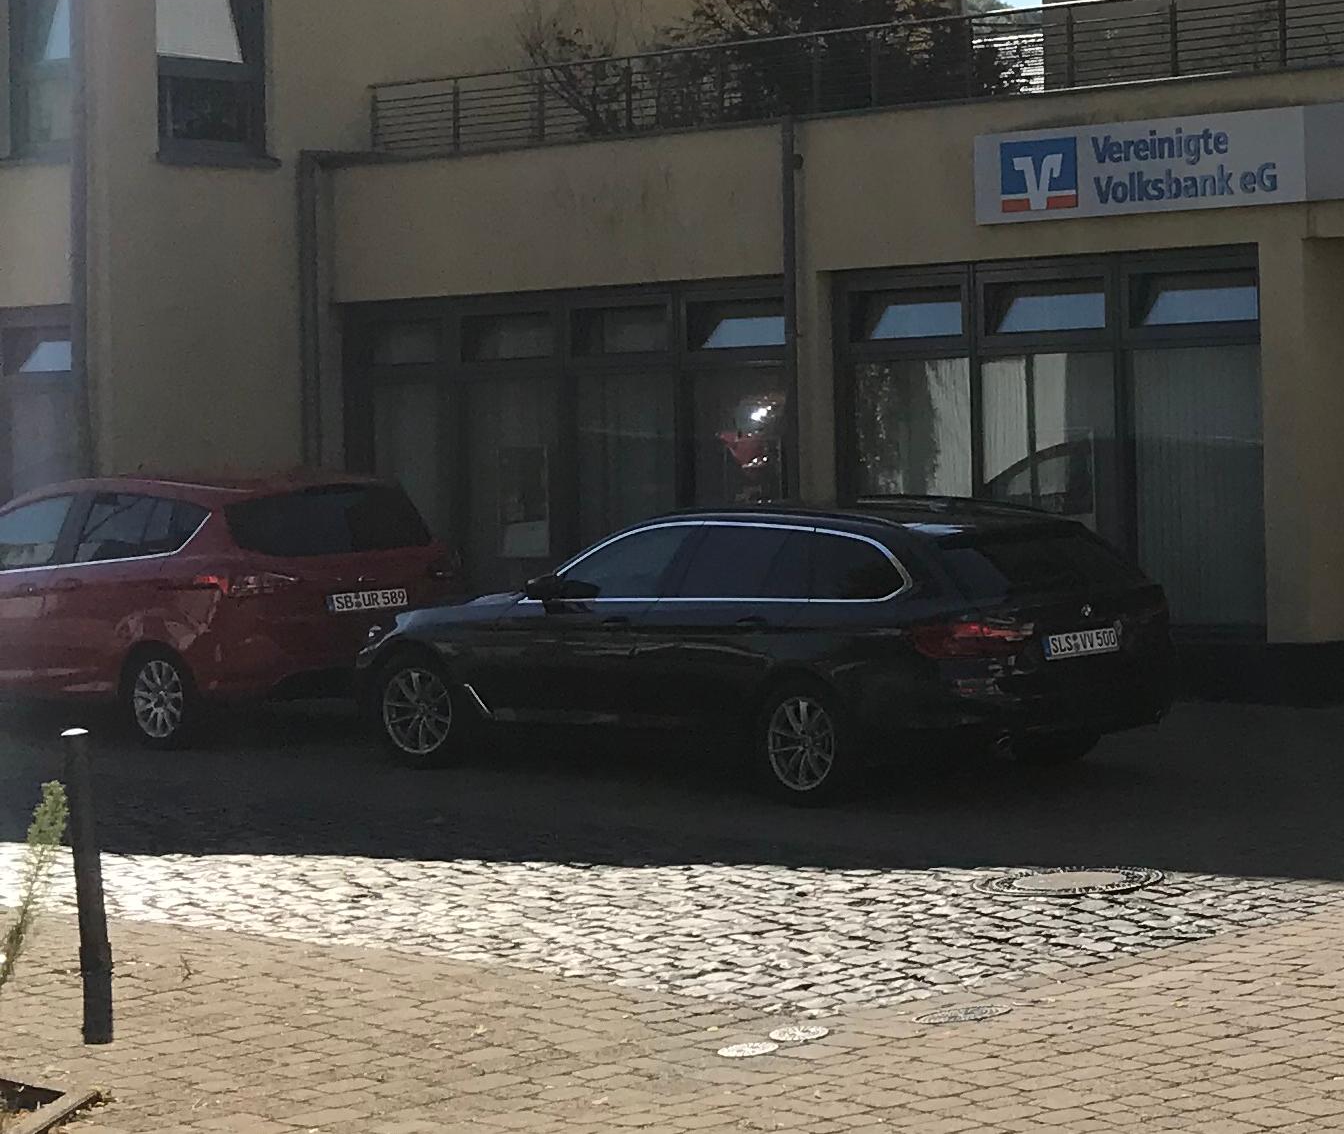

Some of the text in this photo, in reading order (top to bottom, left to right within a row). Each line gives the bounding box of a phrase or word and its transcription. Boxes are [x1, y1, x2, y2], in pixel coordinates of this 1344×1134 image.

[1091, 127, 1229, 165] Vereinigte
[1093, 162, 1278, 205] Volksbank eG
[335, 595, 354, 610] SB
[381, 590, 406, 606] 589
[1051, 635, 1074, 654] SLS
[1095, 630, 1117, 648] 500
